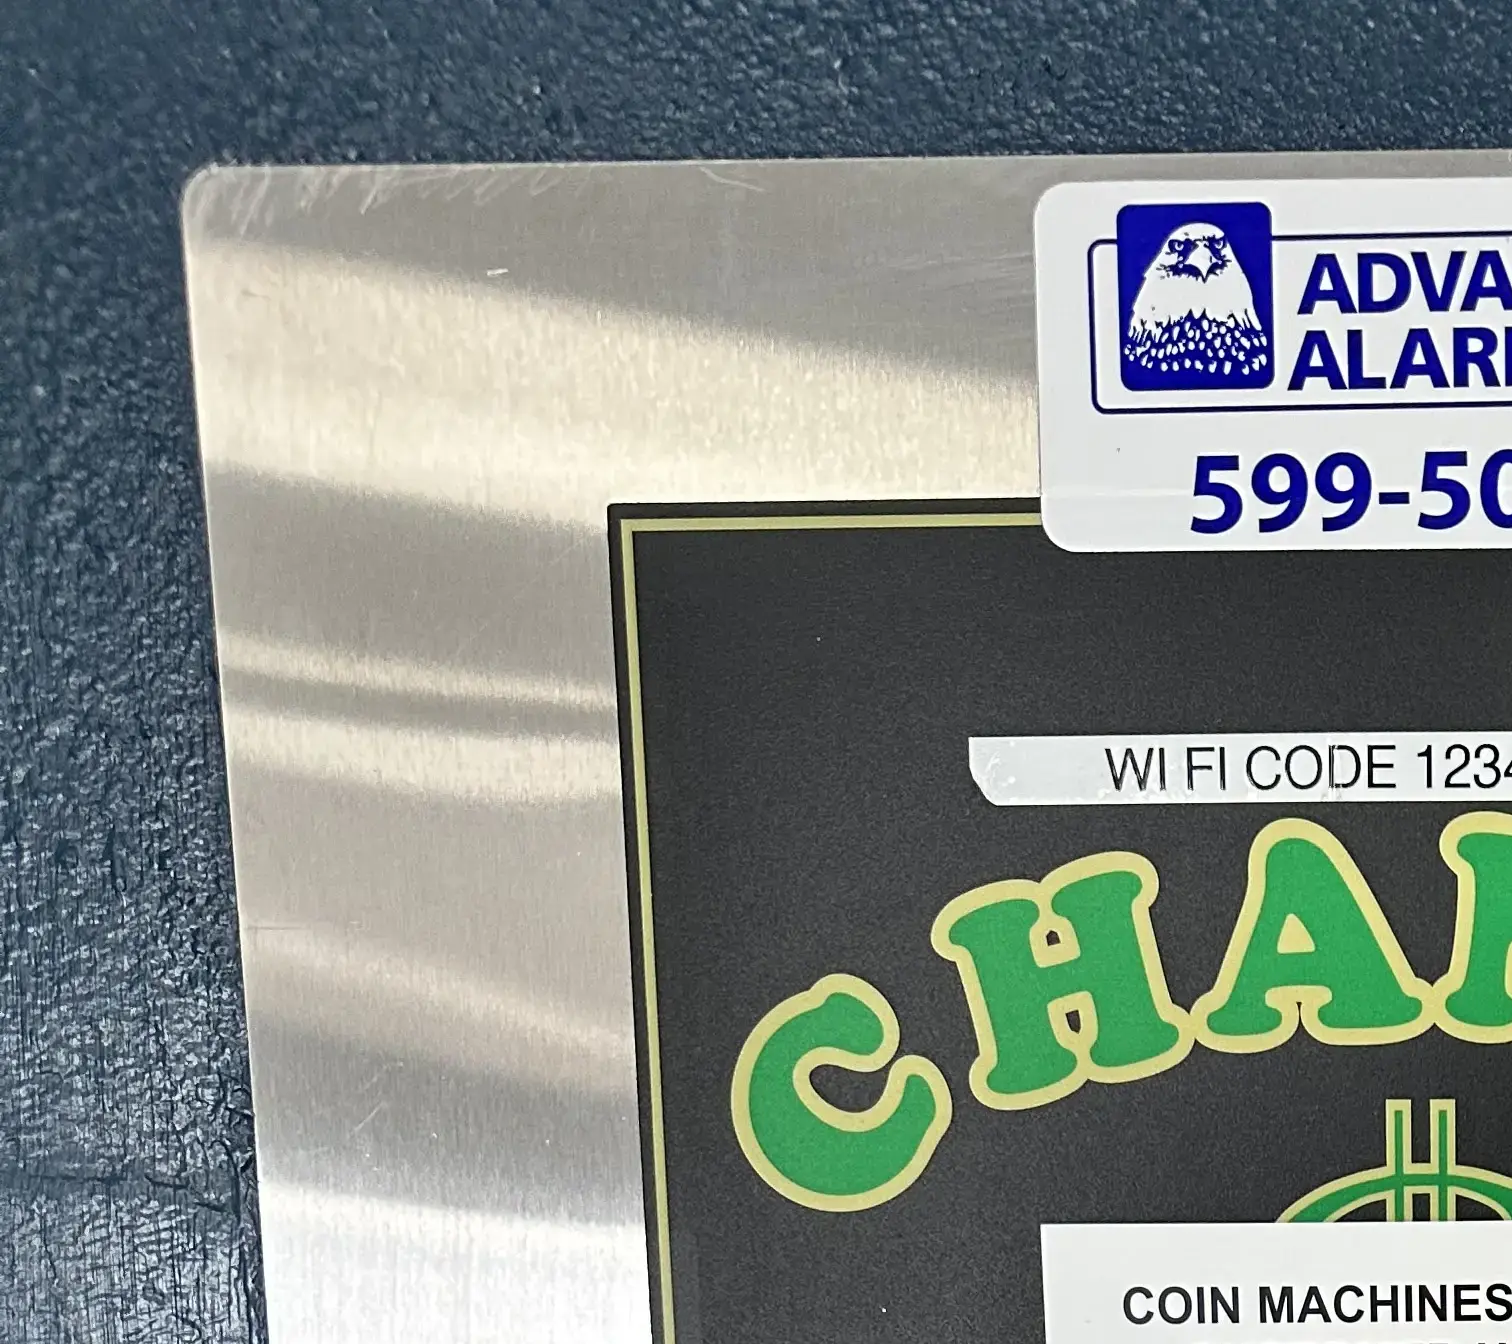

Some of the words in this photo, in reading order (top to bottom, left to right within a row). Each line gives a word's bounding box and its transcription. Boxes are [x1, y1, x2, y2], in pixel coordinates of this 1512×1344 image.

[1104, 747, 1167, 792] WI
[1186, 746, 1226, 792] FI
[1245, 744, 1397, 791] CODE
[1123, 1286, 1240, 1325] COIN
